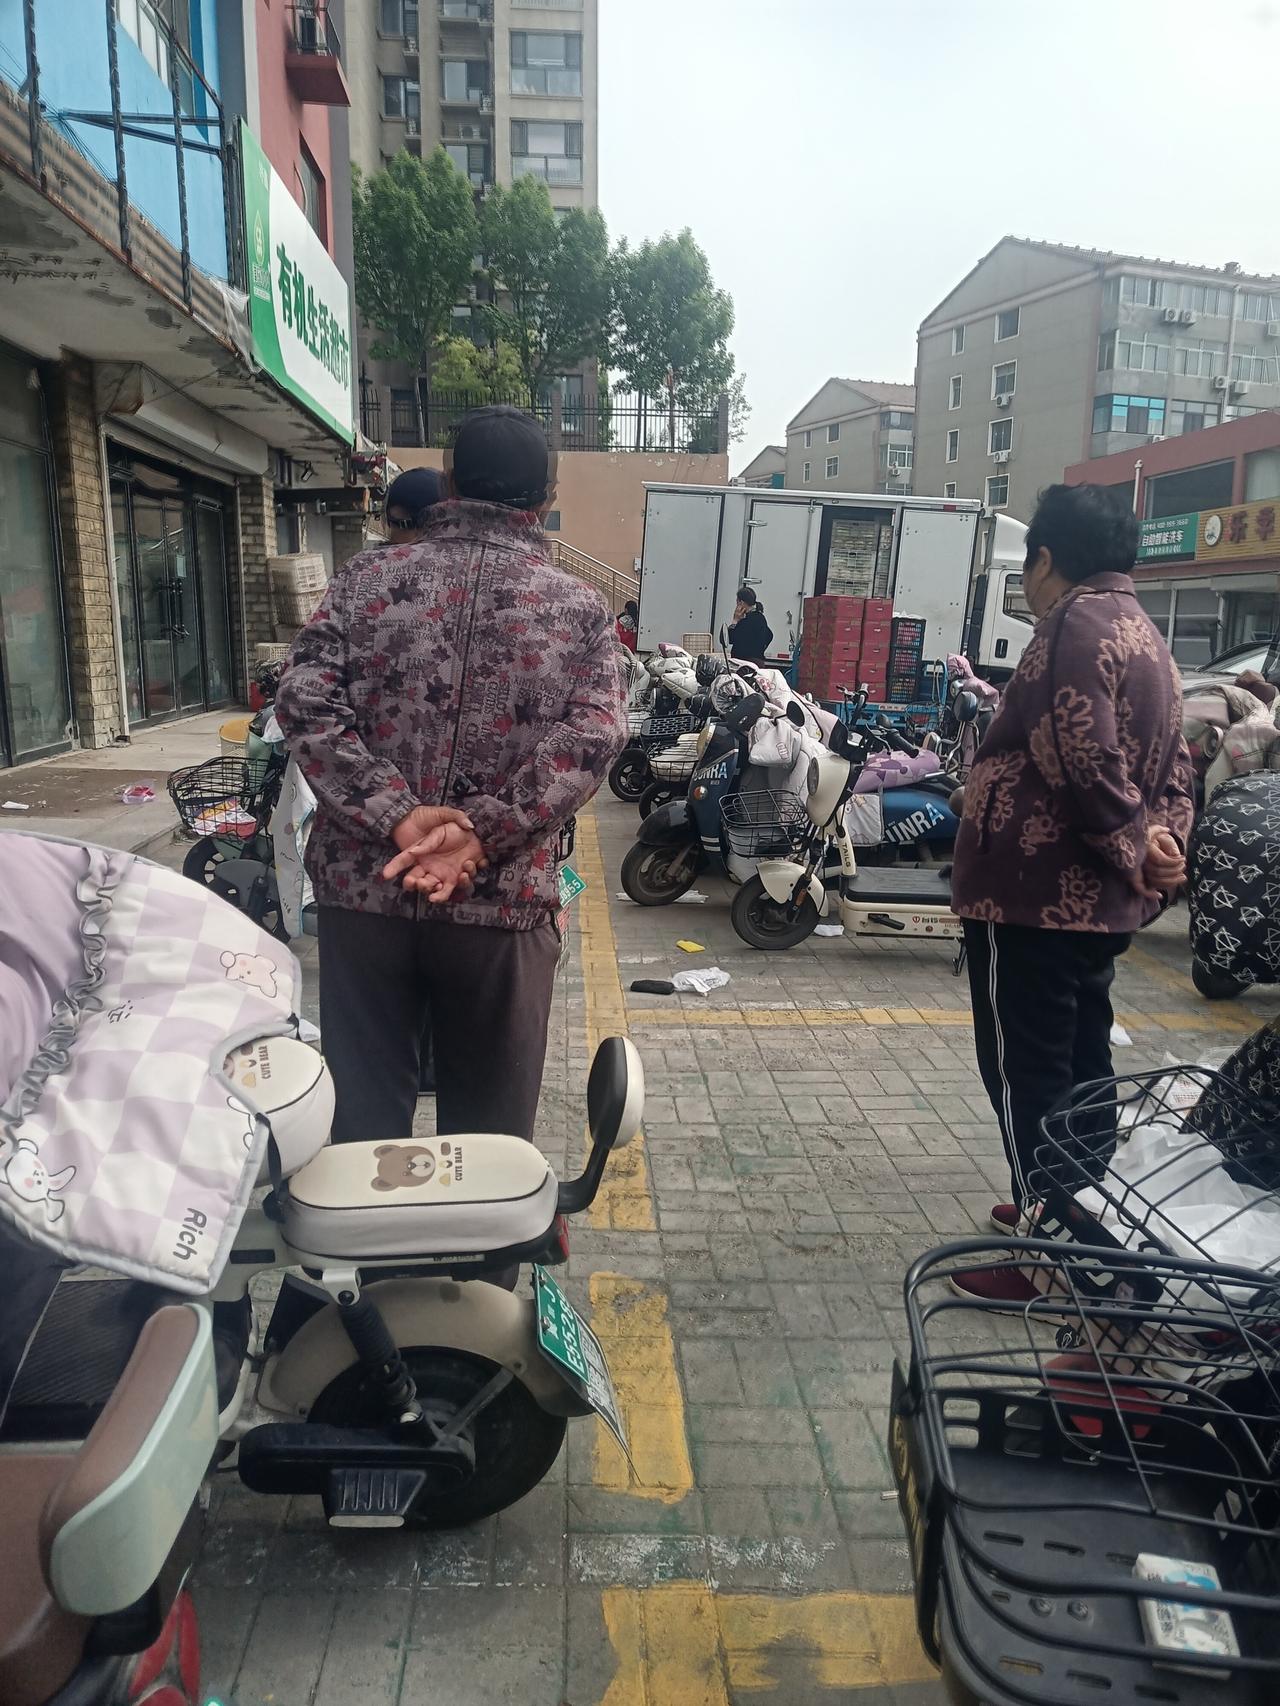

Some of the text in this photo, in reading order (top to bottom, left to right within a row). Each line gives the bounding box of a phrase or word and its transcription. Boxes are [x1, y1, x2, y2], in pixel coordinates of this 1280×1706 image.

[276, 242, 349, 391] 有机生活超市
[884, 802, 945, 843] UNRA
[842, 842, 851, 868] TAILG
[258, 1045, 271, 1080] CUTE BEAR
[454, 1146, 463, 1181] CUTE BEAR
[171, 1207, 208, 1261] Rich
